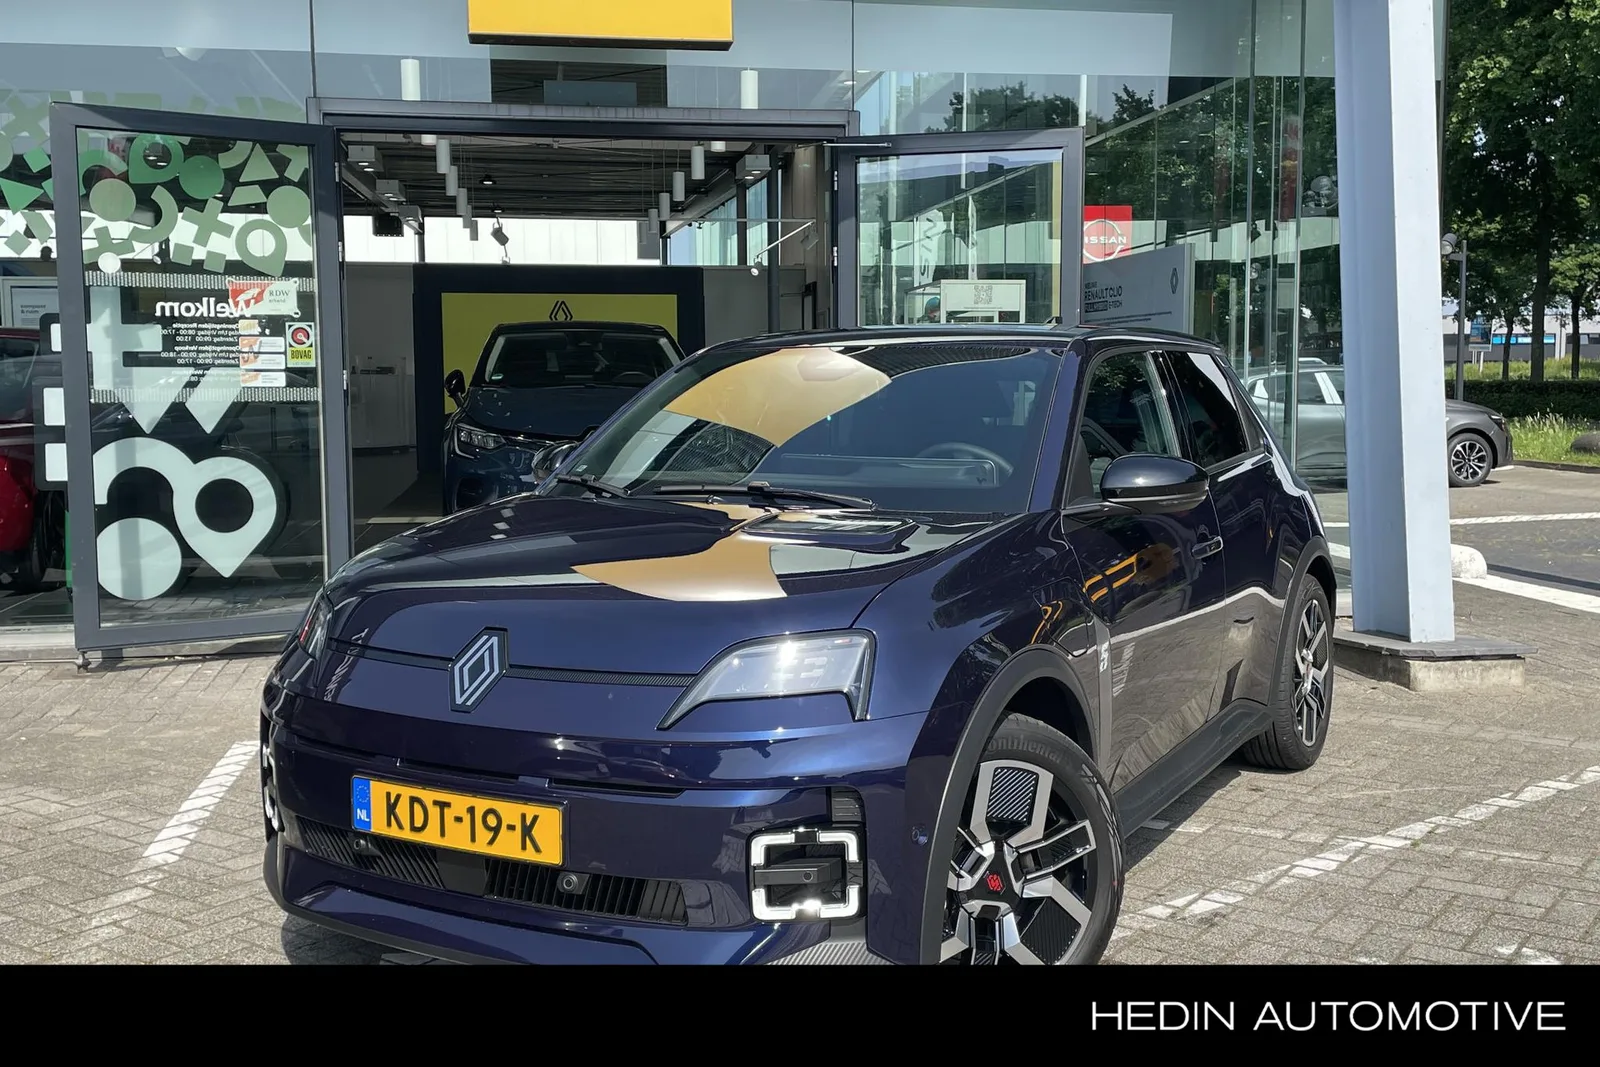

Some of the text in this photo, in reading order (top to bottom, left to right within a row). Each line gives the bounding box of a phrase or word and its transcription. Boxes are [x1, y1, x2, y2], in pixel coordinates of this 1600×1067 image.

[1085, 285, 1122, 301] RENAULT CLIO
[291, 349, 312, 359] BOVAG
[357, 808, 370, 822] NL
[385, 791, 542, 853] KDT-19-K
